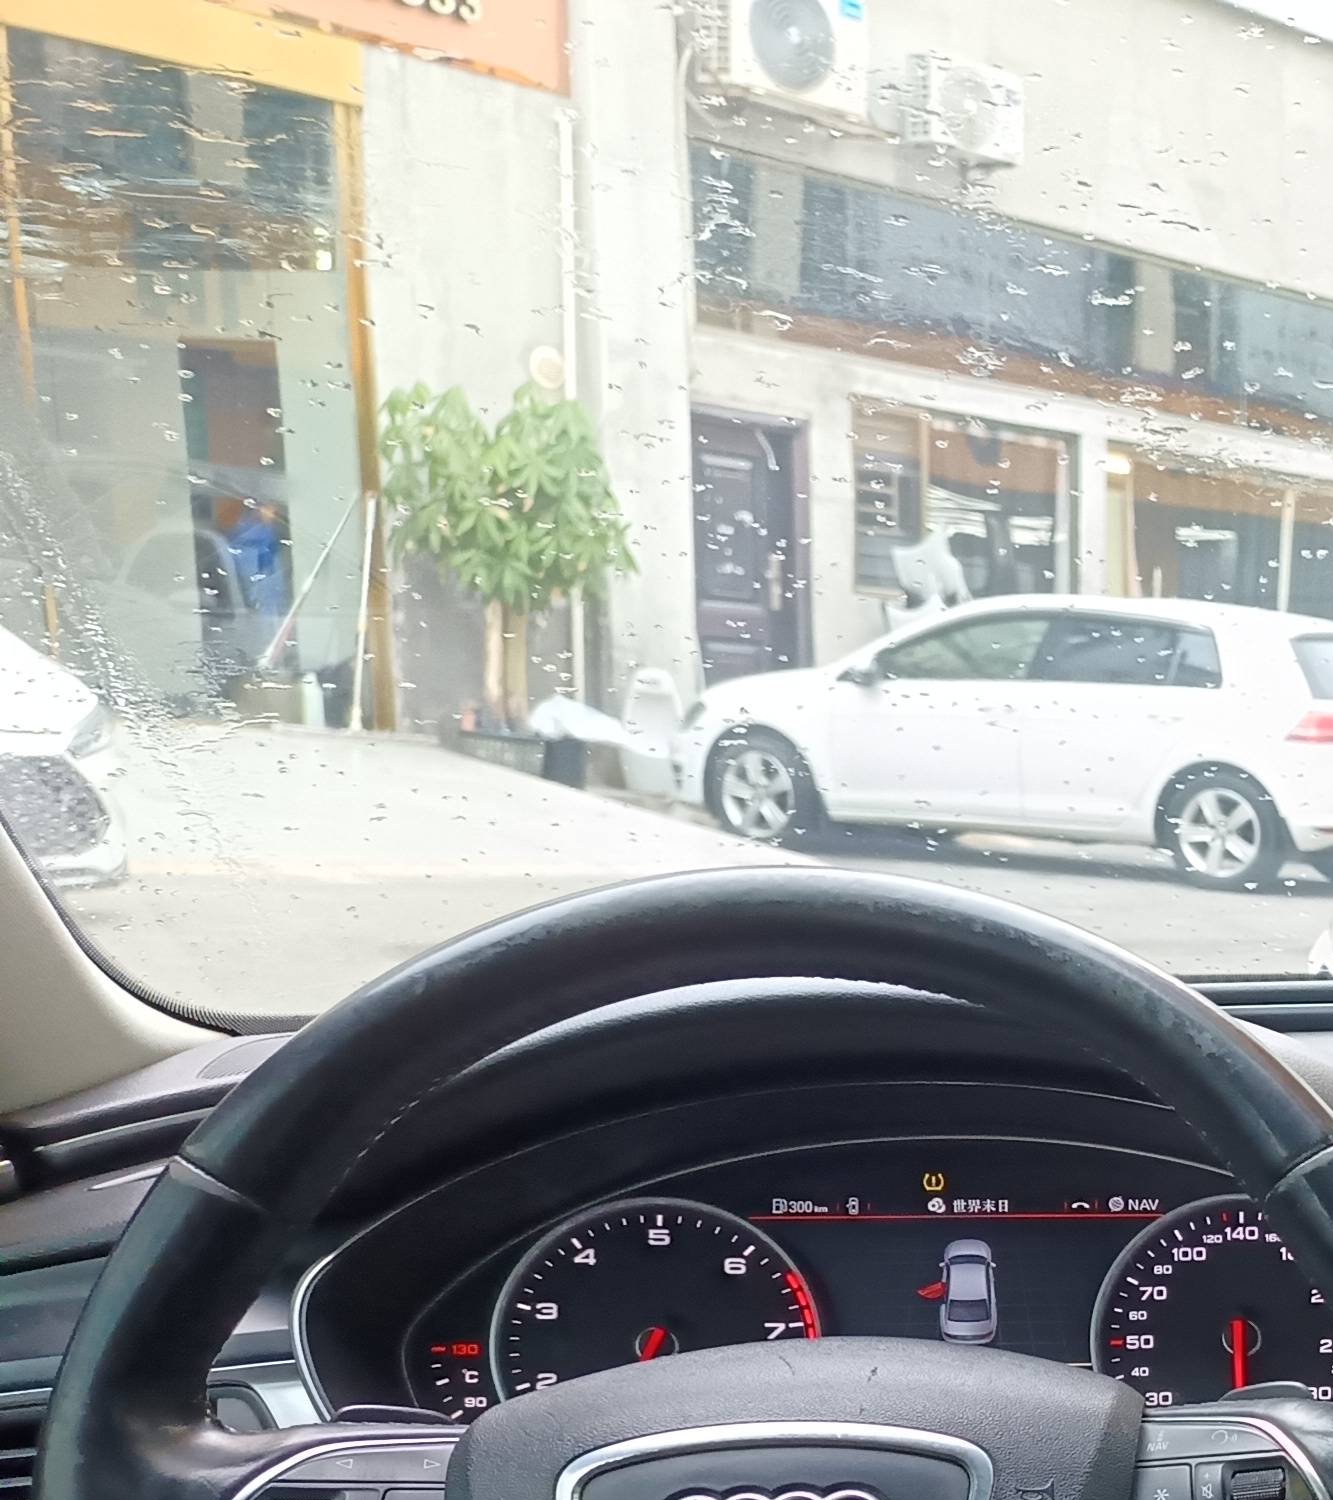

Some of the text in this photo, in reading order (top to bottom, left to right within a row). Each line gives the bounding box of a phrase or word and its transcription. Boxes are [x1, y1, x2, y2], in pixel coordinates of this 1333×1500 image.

[953, 1199, 1009, 1213] 世界末日
[1128, 1199, 1159, 1212] NAV
[647, 1228, 671, 1246] 5
[1202, 1234, 1223, 1244] 120
[1224, 1226, 1258, 1241] 140
[573, 1248, 597, 1266] 4
[1171, 1247, 1207, 1262] 100
[723, 1257, 747, 1275] 6
[1153, 1265, 1172, 1275] 80
[1139, 1286, 1167, 1301] 70
[535, 1302, 559, 1320] 3
[1128, 1310, 1147, 1321] 60
[764, 1322, 788, 1340] 7
[1126, 1335, 1154, 1349] 50
[451, 1343, 479, 1356] 130
[1130, 1366, 1149, 1377] 40
[535, 1373, 558, 1390] 2
[464, 1396, 488, 1408] 90
[1145, 1391, 1173, 1407] 30
[1147, 1441, 1169, 1451] NAV
